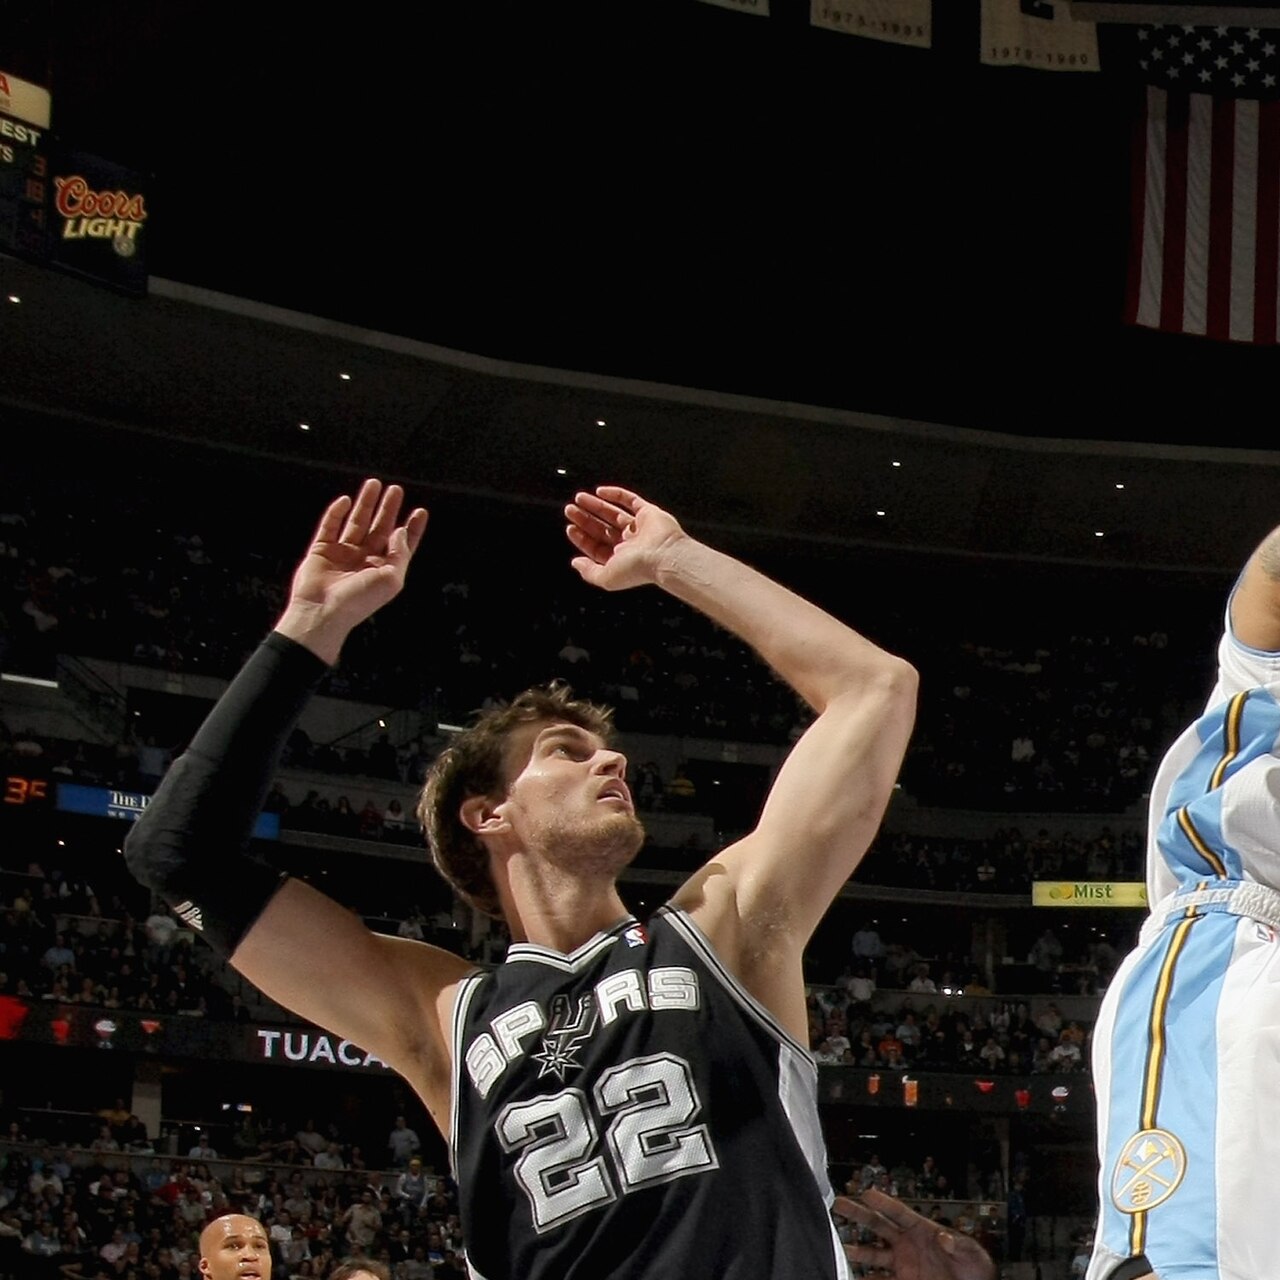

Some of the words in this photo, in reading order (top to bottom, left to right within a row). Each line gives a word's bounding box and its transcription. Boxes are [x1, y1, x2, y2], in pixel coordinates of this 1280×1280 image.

[0, 118, 41, 146] EST
[53, 175, 147, 221] Coors
[63, 217, 143, 240] LIGHT
[1074, 885, 1112, 898] Mist
[465, 966, 699, 1099] SPURS
[494, 1051, 720, 1235] 22
